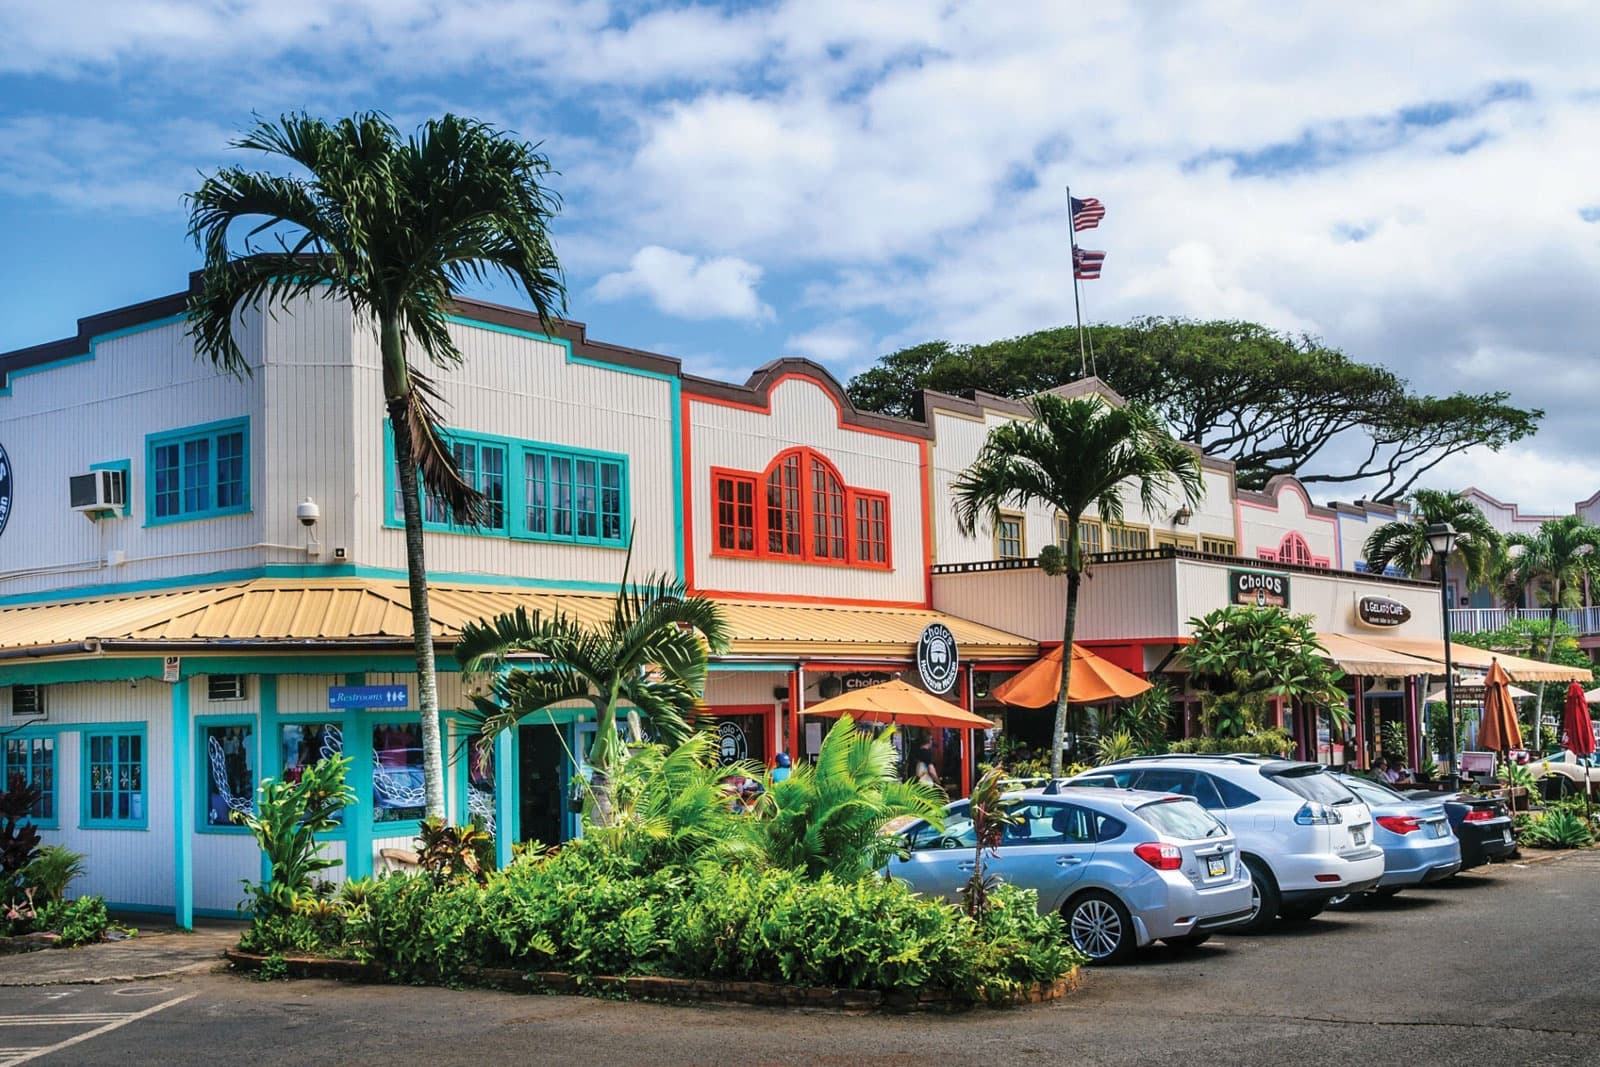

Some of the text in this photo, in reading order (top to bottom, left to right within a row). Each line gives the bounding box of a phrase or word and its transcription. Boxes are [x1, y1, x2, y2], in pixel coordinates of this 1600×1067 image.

[923, 626, 953, 646] Cholo's
[337, 692, 383, 702] Restrooms
[713, 724, 742, 742] holo's
